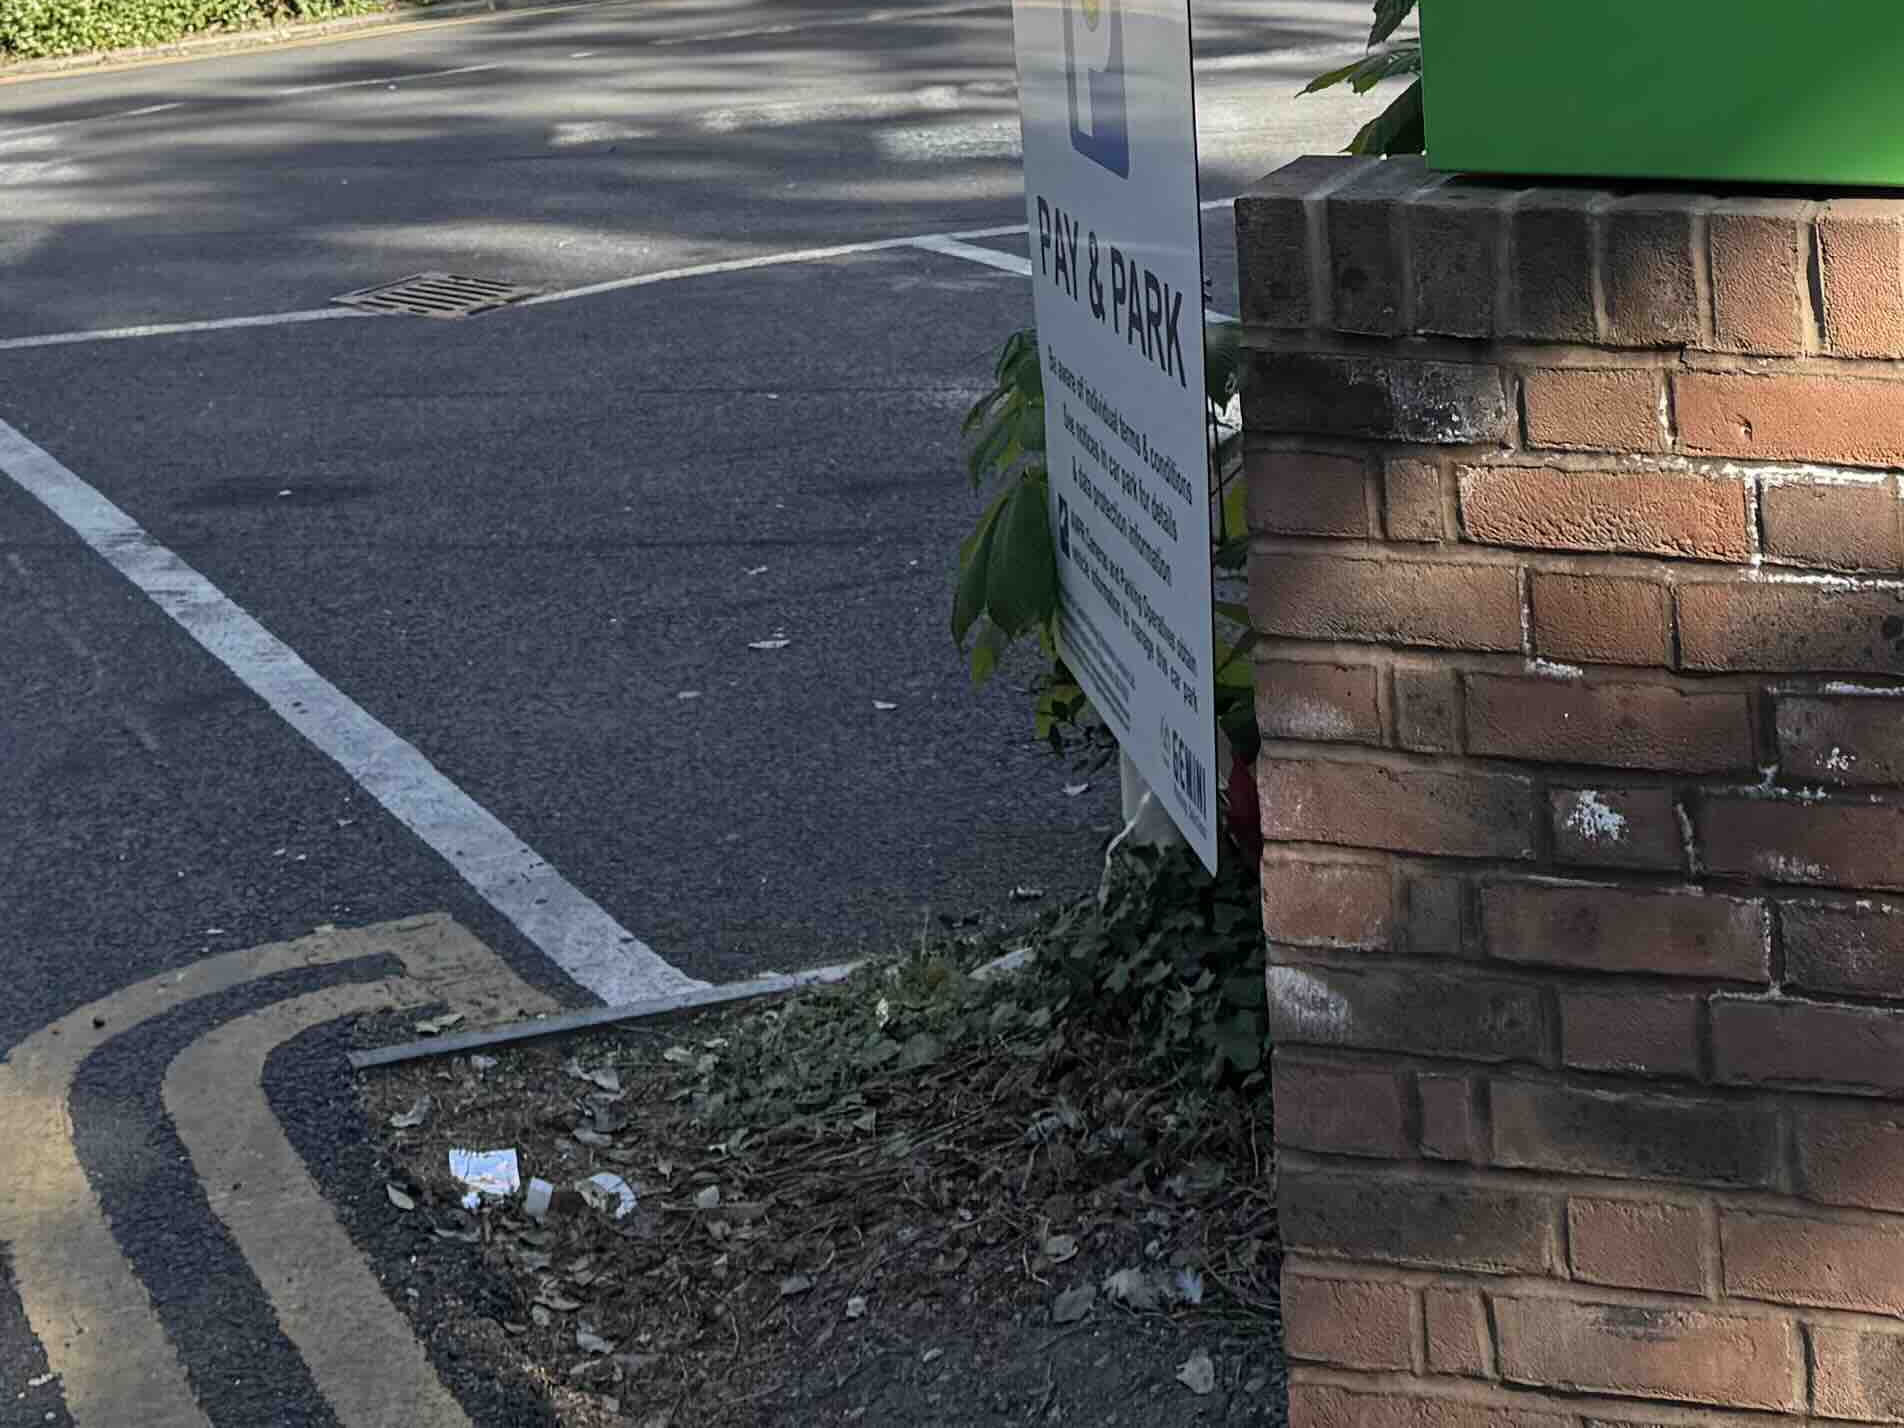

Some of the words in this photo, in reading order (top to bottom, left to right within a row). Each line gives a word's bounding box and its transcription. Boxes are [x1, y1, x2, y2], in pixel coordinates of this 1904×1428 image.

[1037, 195, 1079, 302] PAY
[1088, 229, 1105, 324] &
[1110, 245, 1186, 388] PARK
[1076, 420, 1100, 464] notices
[1109, 456, 1120, 481] car
[1121, 467, 1138, 502] park
[1139, 479, 1150, 512] for
[1085, 387, 1118, 434] individual
[1119, 413, 1140, 457] terms
[1142, 433, 1149, 464] &
[1150, 447, 1193, 506] conditions
[1093, 485, 1127, 539] protection
